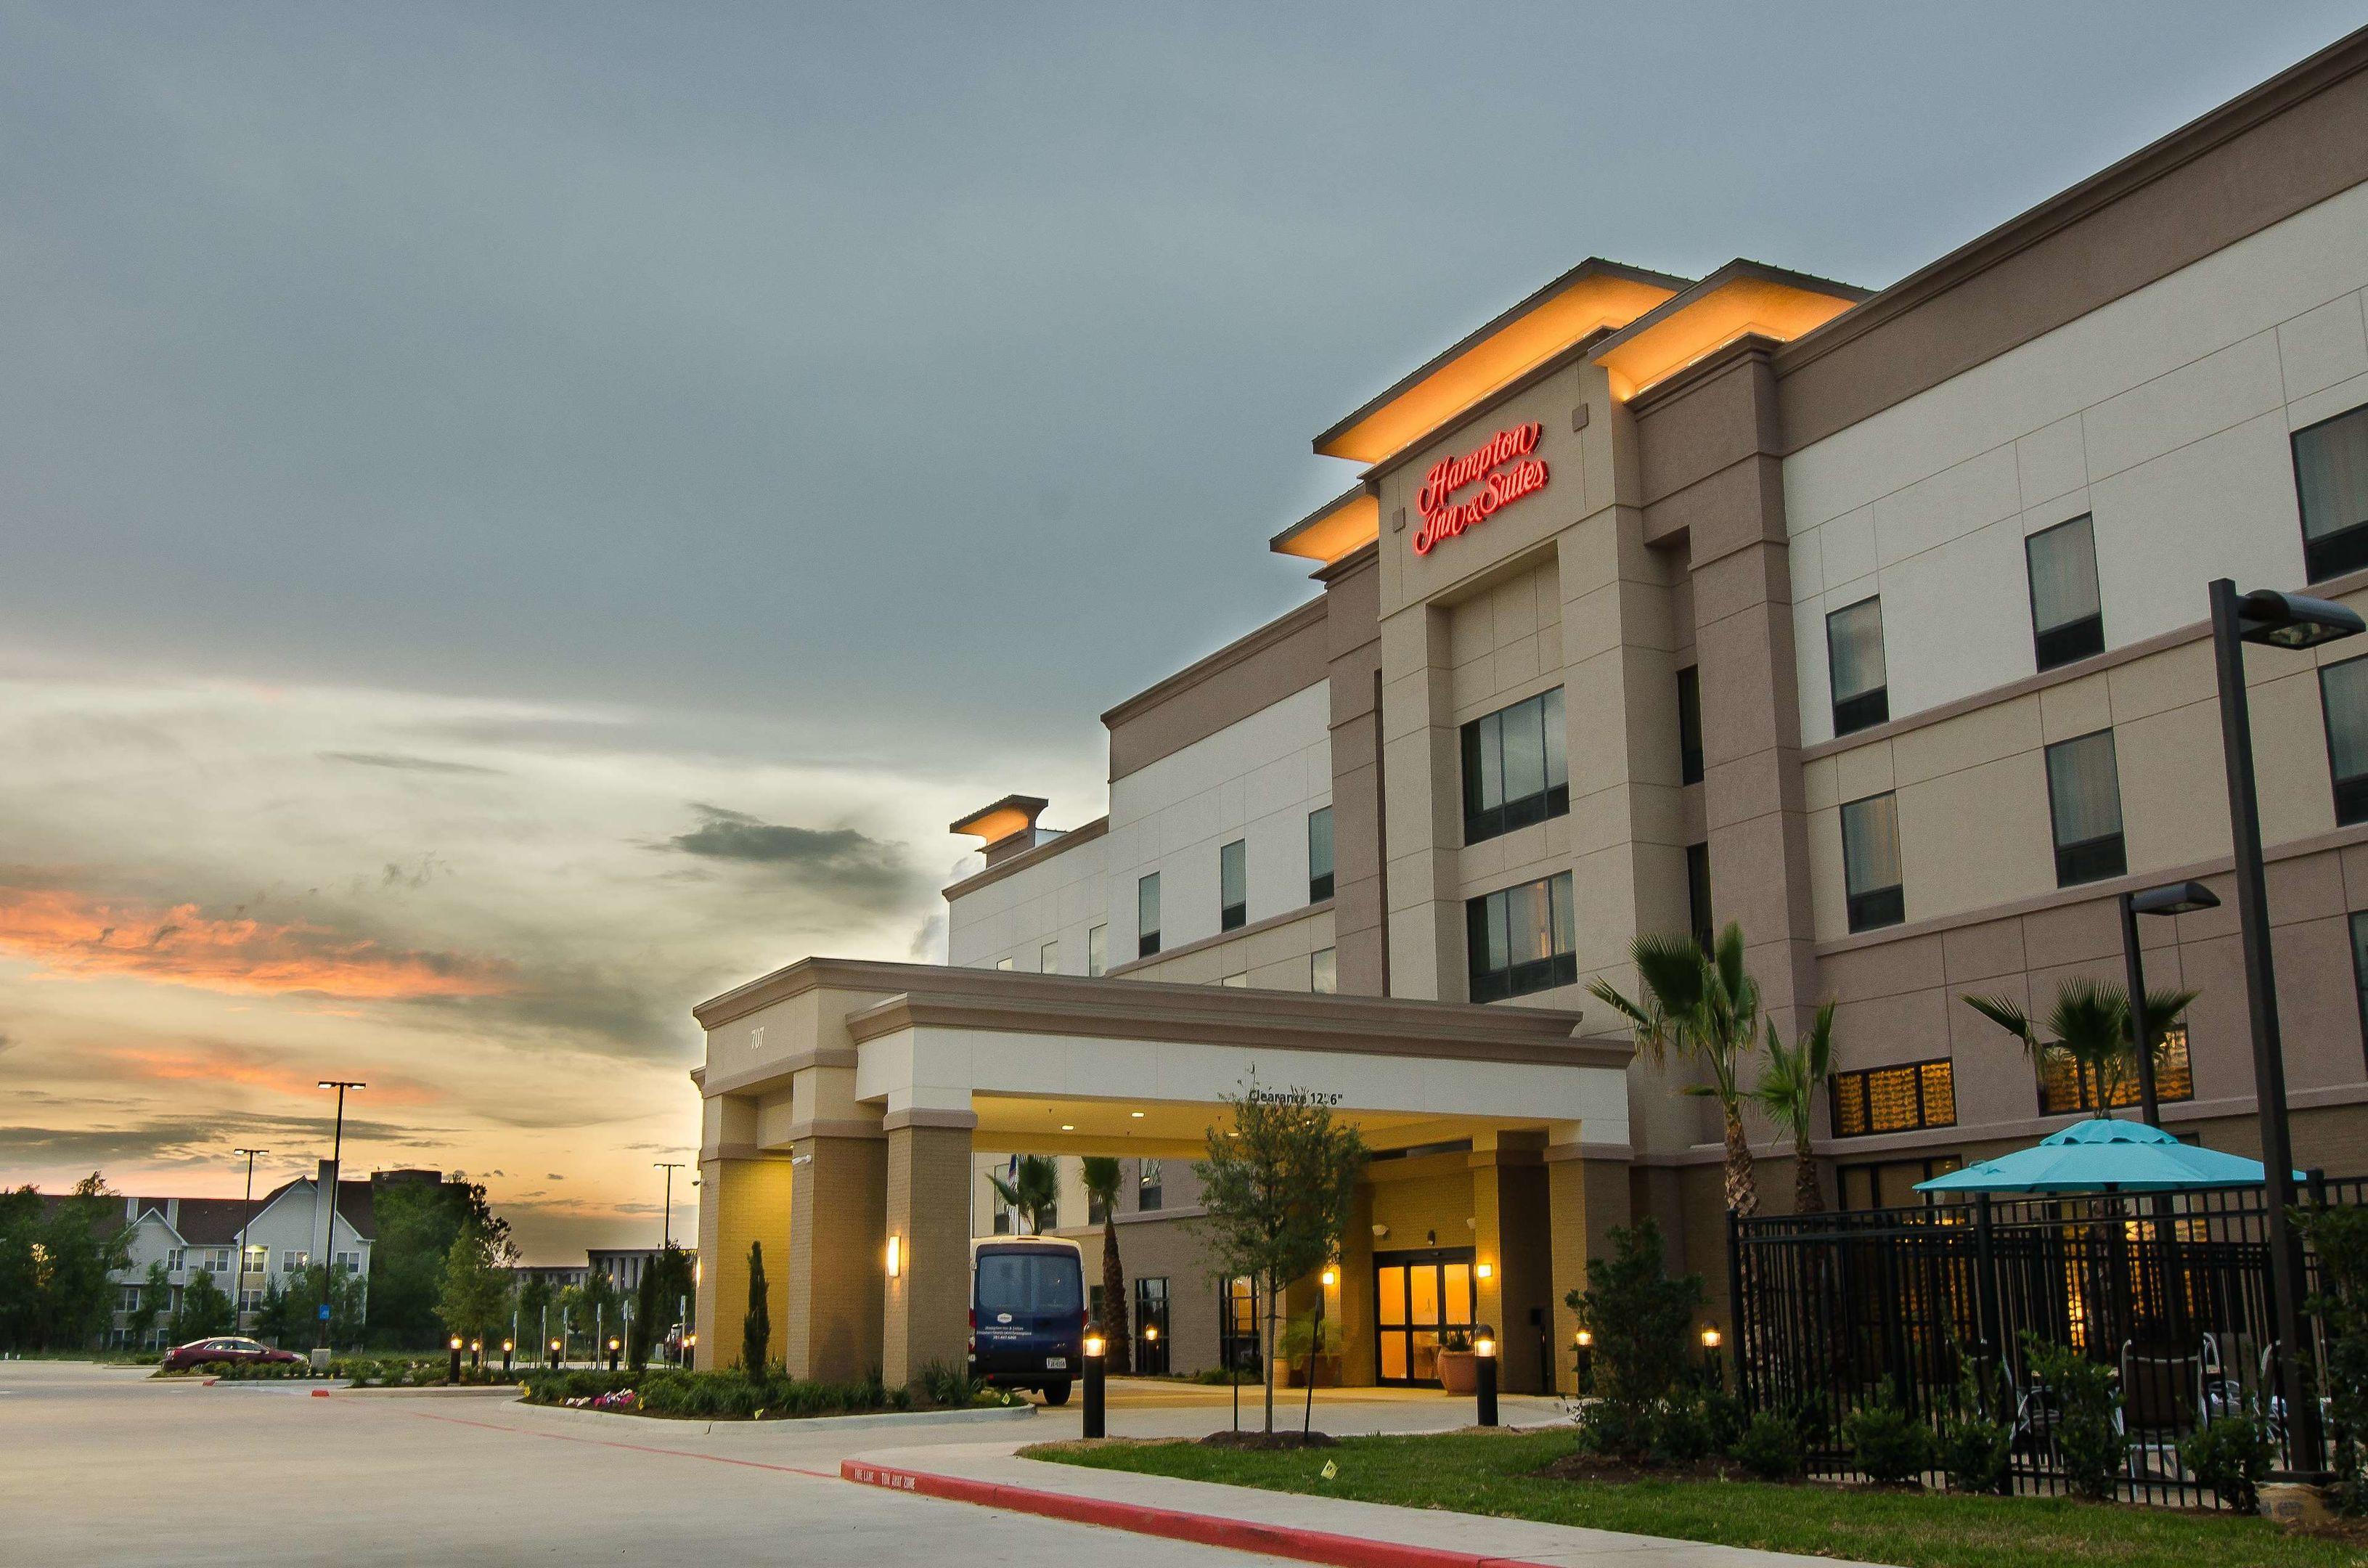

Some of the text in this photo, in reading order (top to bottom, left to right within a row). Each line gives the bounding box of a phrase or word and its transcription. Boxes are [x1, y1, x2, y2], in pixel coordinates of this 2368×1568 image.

[1413, 459, 1549, 556] Inn & Suites
[1418, 421, 1543, 516] Hampton
[751, 1026, 765, 1050] 707
